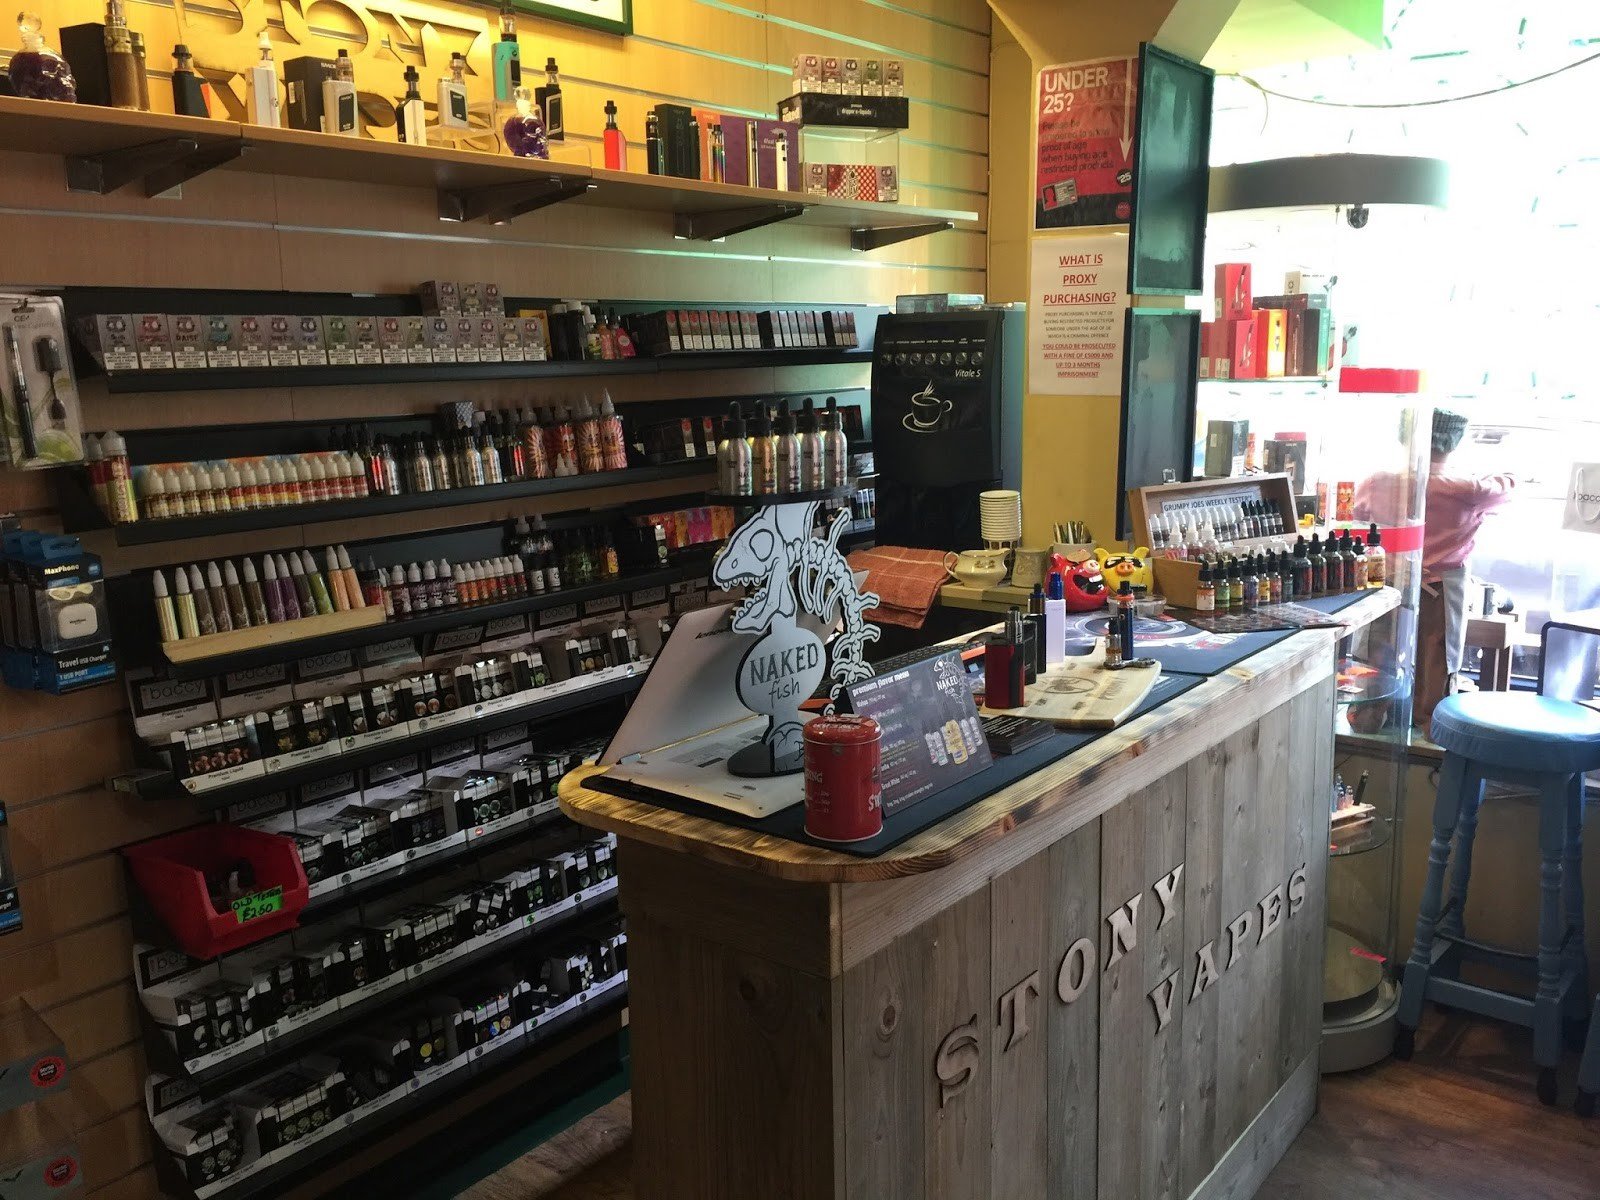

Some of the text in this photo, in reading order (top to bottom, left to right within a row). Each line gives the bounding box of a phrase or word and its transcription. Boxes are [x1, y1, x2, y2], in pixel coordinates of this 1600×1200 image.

[1044, 66, 1109, 94] UNDER
[1043, 92, 1074, 114] 25?
[1042, 141, 1088, 152] proof of age
[1042, 154, 1063, 163] when
[1064, 152, 1091, 164] buying
[1041, 160, 1114, 174] restricted products
[1059, 254, 1103, 266] WHAT IS
[1063, 274, 1098, 284] PROXY
[1043, 292, 1116, 304] PURCHASING?
[955, 369, 981, 377] Vitale S
[1164, 502, 1189, 511] GRUMPY
[1191, 500, 1204, 508] JOES
[1205, 498, 1228, 507] WEEKLY
[44, 564, 80, 575] MaxPhone
[58, 657, 78, 669] Travel
[750, 642, 819, 686] NAKED
[852, 682, 878, 697] premium
[936, 676, 958, 690] NAKED
[768, 678, 800, 709] fish
[232, 898, 252, 910] OLD
[1146, 863, 1307, 1036] VAPES
[936, 862, 1184, 1108] STONY
